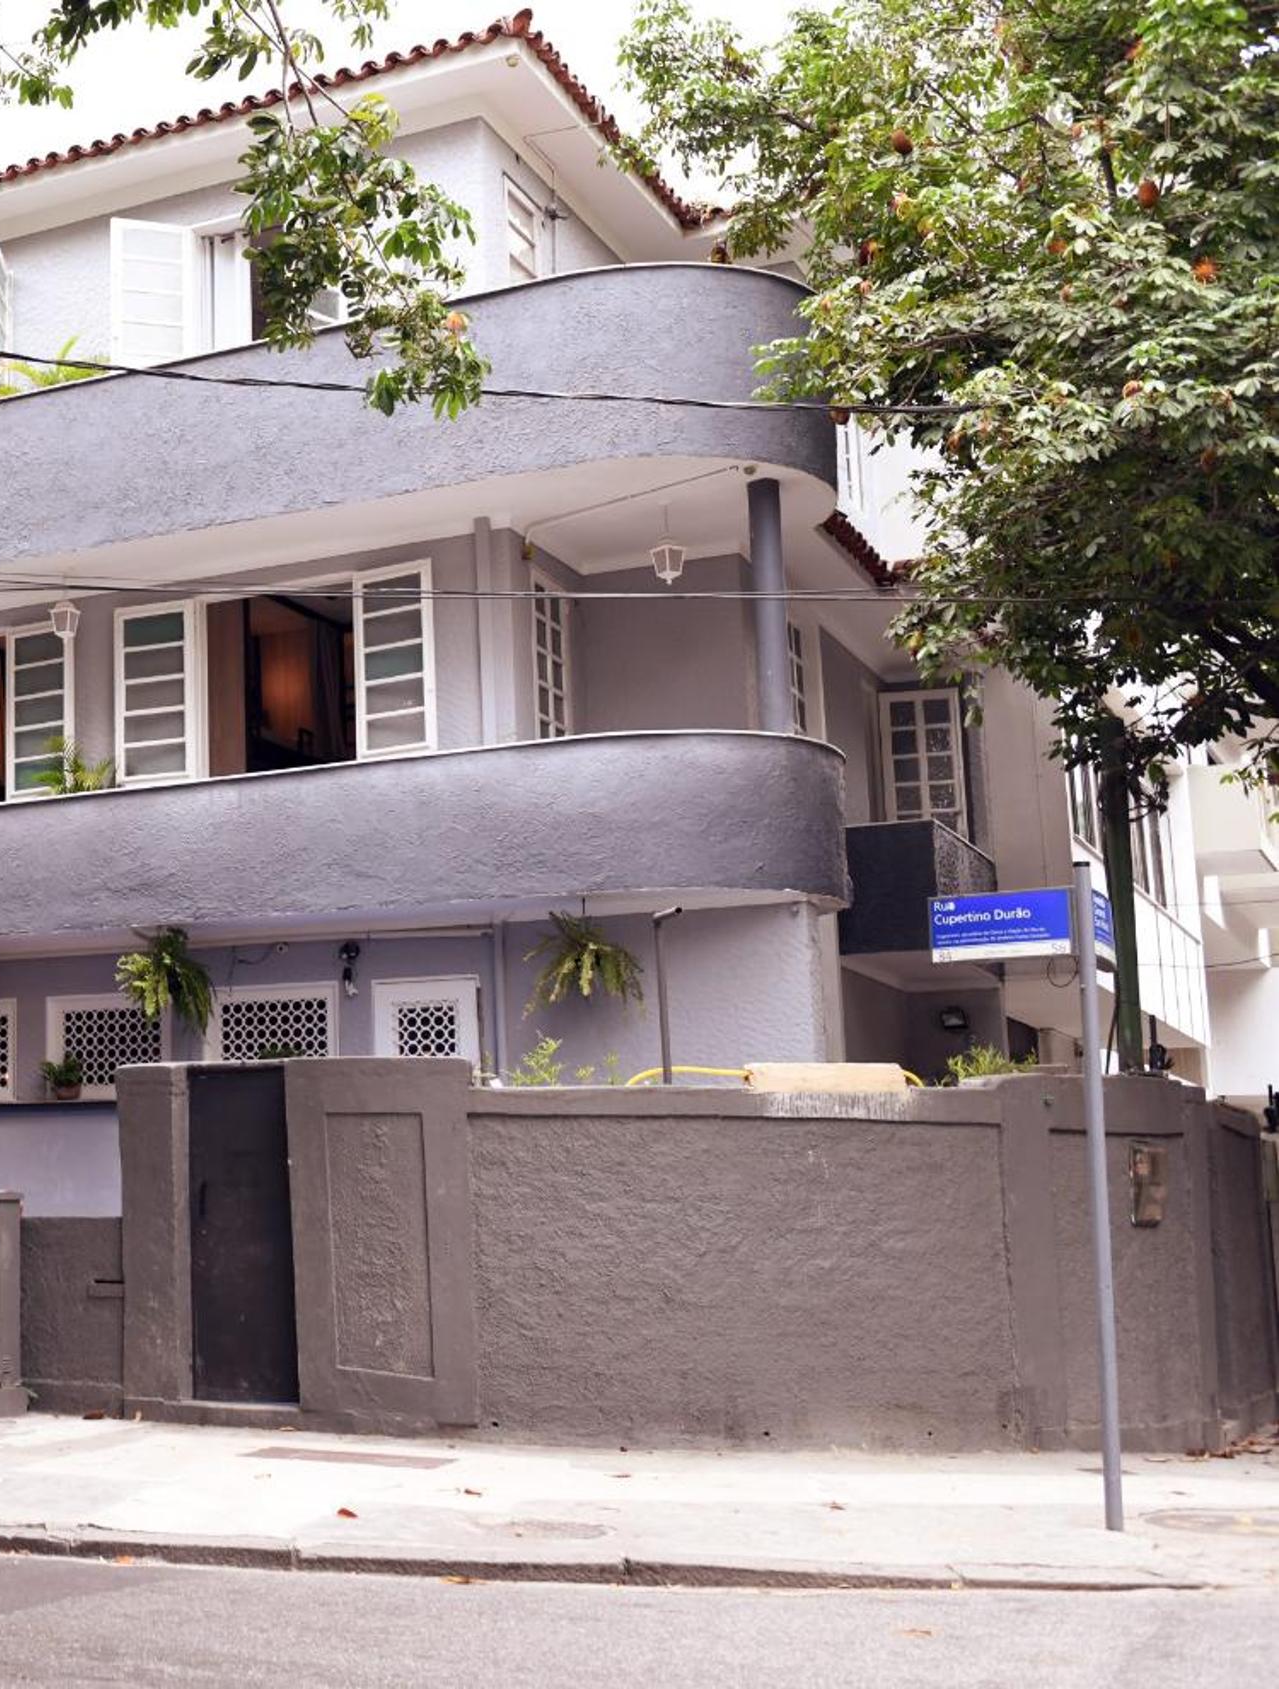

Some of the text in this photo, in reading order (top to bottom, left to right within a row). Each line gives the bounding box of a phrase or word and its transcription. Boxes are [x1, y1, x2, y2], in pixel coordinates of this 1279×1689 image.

[933, 901, 956, 912] Rua
[933, 906, 1031, 926] Cupertino Durão
